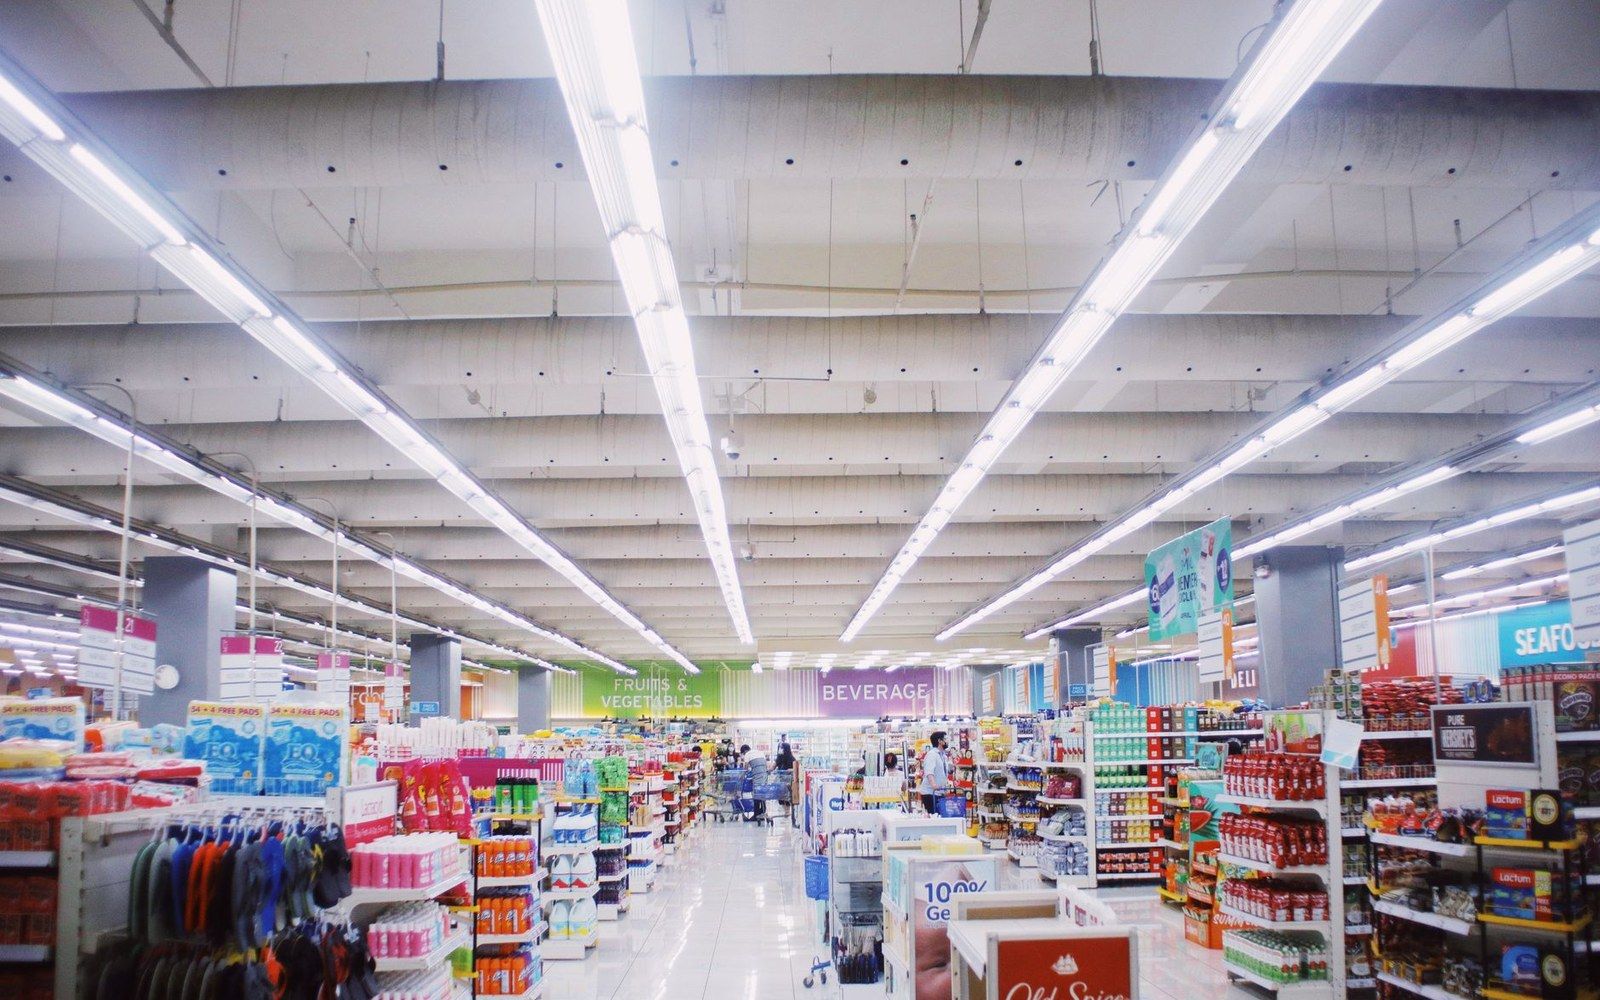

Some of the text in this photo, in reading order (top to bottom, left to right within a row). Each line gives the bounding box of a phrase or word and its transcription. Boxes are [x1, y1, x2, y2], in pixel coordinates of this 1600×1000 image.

[1514, 623, 1600, 656] SEAFO
[614, 678, 688, 691] FRUITS &
[822, 683, 929, 701] BEVERAGE
[602, 695, 703, 708] VEGETABLES
[51, 705, 73, 713] PADS
[218, 707, 236, 715] FREE
[239, 707, 260, 716] PADS
[298, 707, 316, 716] FREE
[319, 708, 340, 717] PADS
[1447, 715, 1465, 725] PURE
[287, 743, 319, 764] EQ
[1492, 795, 1522, 804] Lactum
[1499, 873, 1531, 883] Lactum
